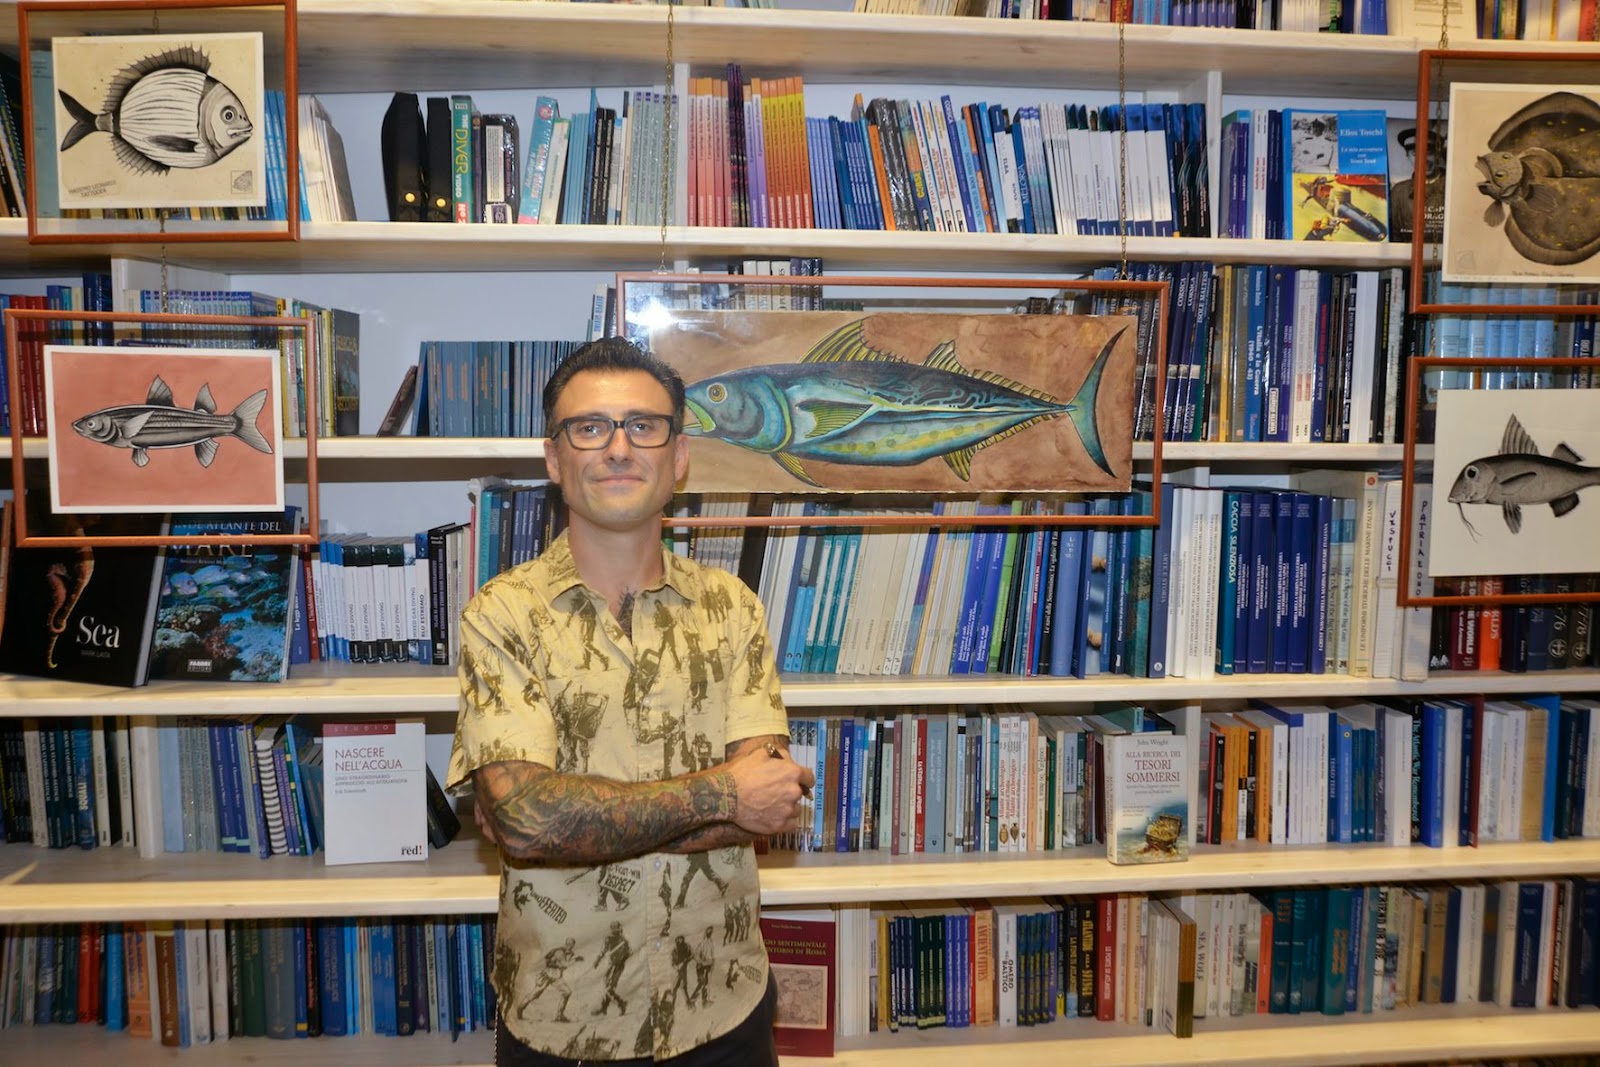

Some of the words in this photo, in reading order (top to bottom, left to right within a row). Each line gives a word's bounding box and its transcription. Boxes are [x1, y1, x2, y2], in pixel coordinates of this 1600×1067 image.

[944, 100, 954, 123] CORSICA
[455, 129, 469, 174] DIVER
[455, 174, 463, 198] VIDEO
[1018, 165, 1030, 204] MELORIA
[1177, 277, 1187, 307] CORSICA
[1187, 276, 1197, 307] CORSICA
[1199, 271, 1209, 302] MALTESI
[1197, 303, 1206, 323] ISOLE
[1255, 326, 1263, 352] L'Italia
[1254, 370, 1263, 396] Guerra
[207, 521, 256, 531] ATLANTE
[260, 521, 281, 532] DEL
[1230, 500, 1240, 532] CACCIA
[1366, 499, 1374, 529] ITALIANE
[1417, 501, 1428, 556] PATRIA
[1364, 530, 1372, 555] MARINE
[1228, 535, 1238, 584] SILENZIOSA
[1160, 579, 1168, 604] STORIA
[1361, 579, 1369, 609] STORICHE
[348, 603, 356, 624] DIVING
[1360, 611, 1368, 642] UNIFORMI
[76, 616, 121, 648] Sea
[1466, 619, 1475, 655] WORLD
[1359, 643, 1366, 652] LE
[335, 747, 384, 759] NASCERE
[1151, 738, 1168, 747] Wright
[335, 759, 403, 772] NELL'ACQUA
[1126, 771, 1181, 783] SOMMERSI
[1135, 759, 1172, 770] TESORI
[1412, 761, 1420, 775] War
[1411, 775, 1420, 821] Remembered
[401, 845, 422, 856] red!
[605, 874, 636, 894] RESPECT
[778, 940, 827, 949] SENTIMENTALE
[1082, 919, 1094, 951] ATLANTIDE
[1197, 952, 1205, 982] WOLF
[1082, 969, 1093, 996] SFINGE
